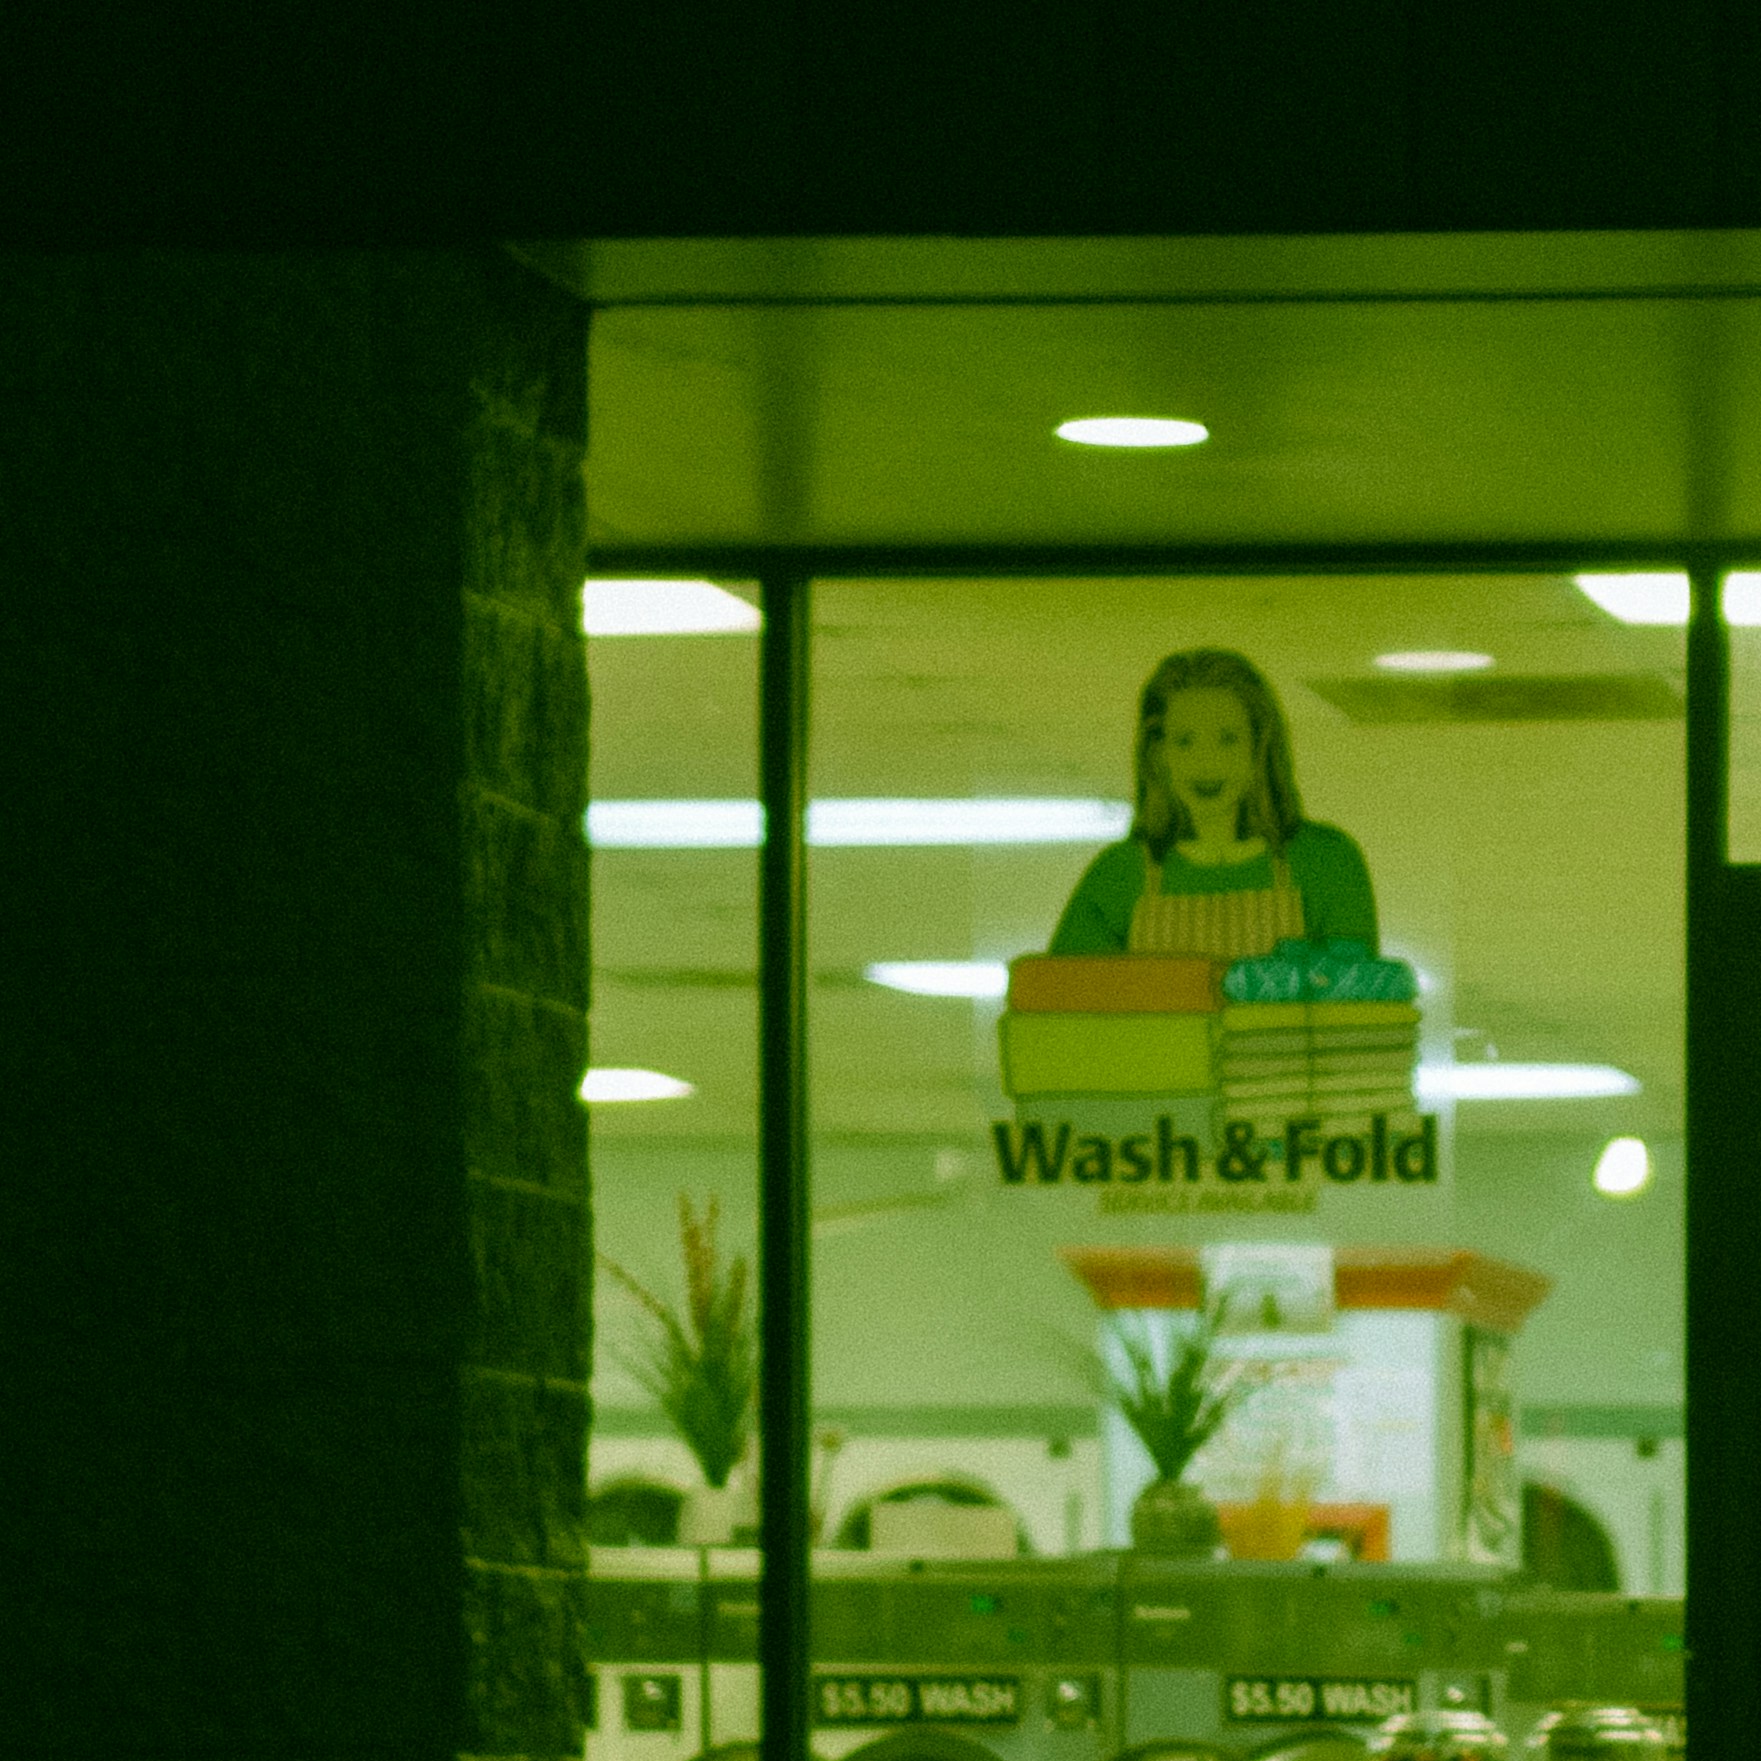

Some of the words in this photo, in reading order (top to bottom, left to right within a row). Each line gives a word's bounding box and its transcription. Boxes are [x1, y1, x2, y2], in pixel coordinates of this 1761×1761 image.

[992, 1112, 1198, 1186] Wash
[1215, 1117, 1266, 1185] &
[1285, 1112, 1437, 1186] Fold
[822, 1681, 911, 1718] $5.50
[920, 1681, 1016, 1716] WASH
[1231, 1680, 1314, 1717] $5.50
[1322, 1680, 1412, 1717] WASH
